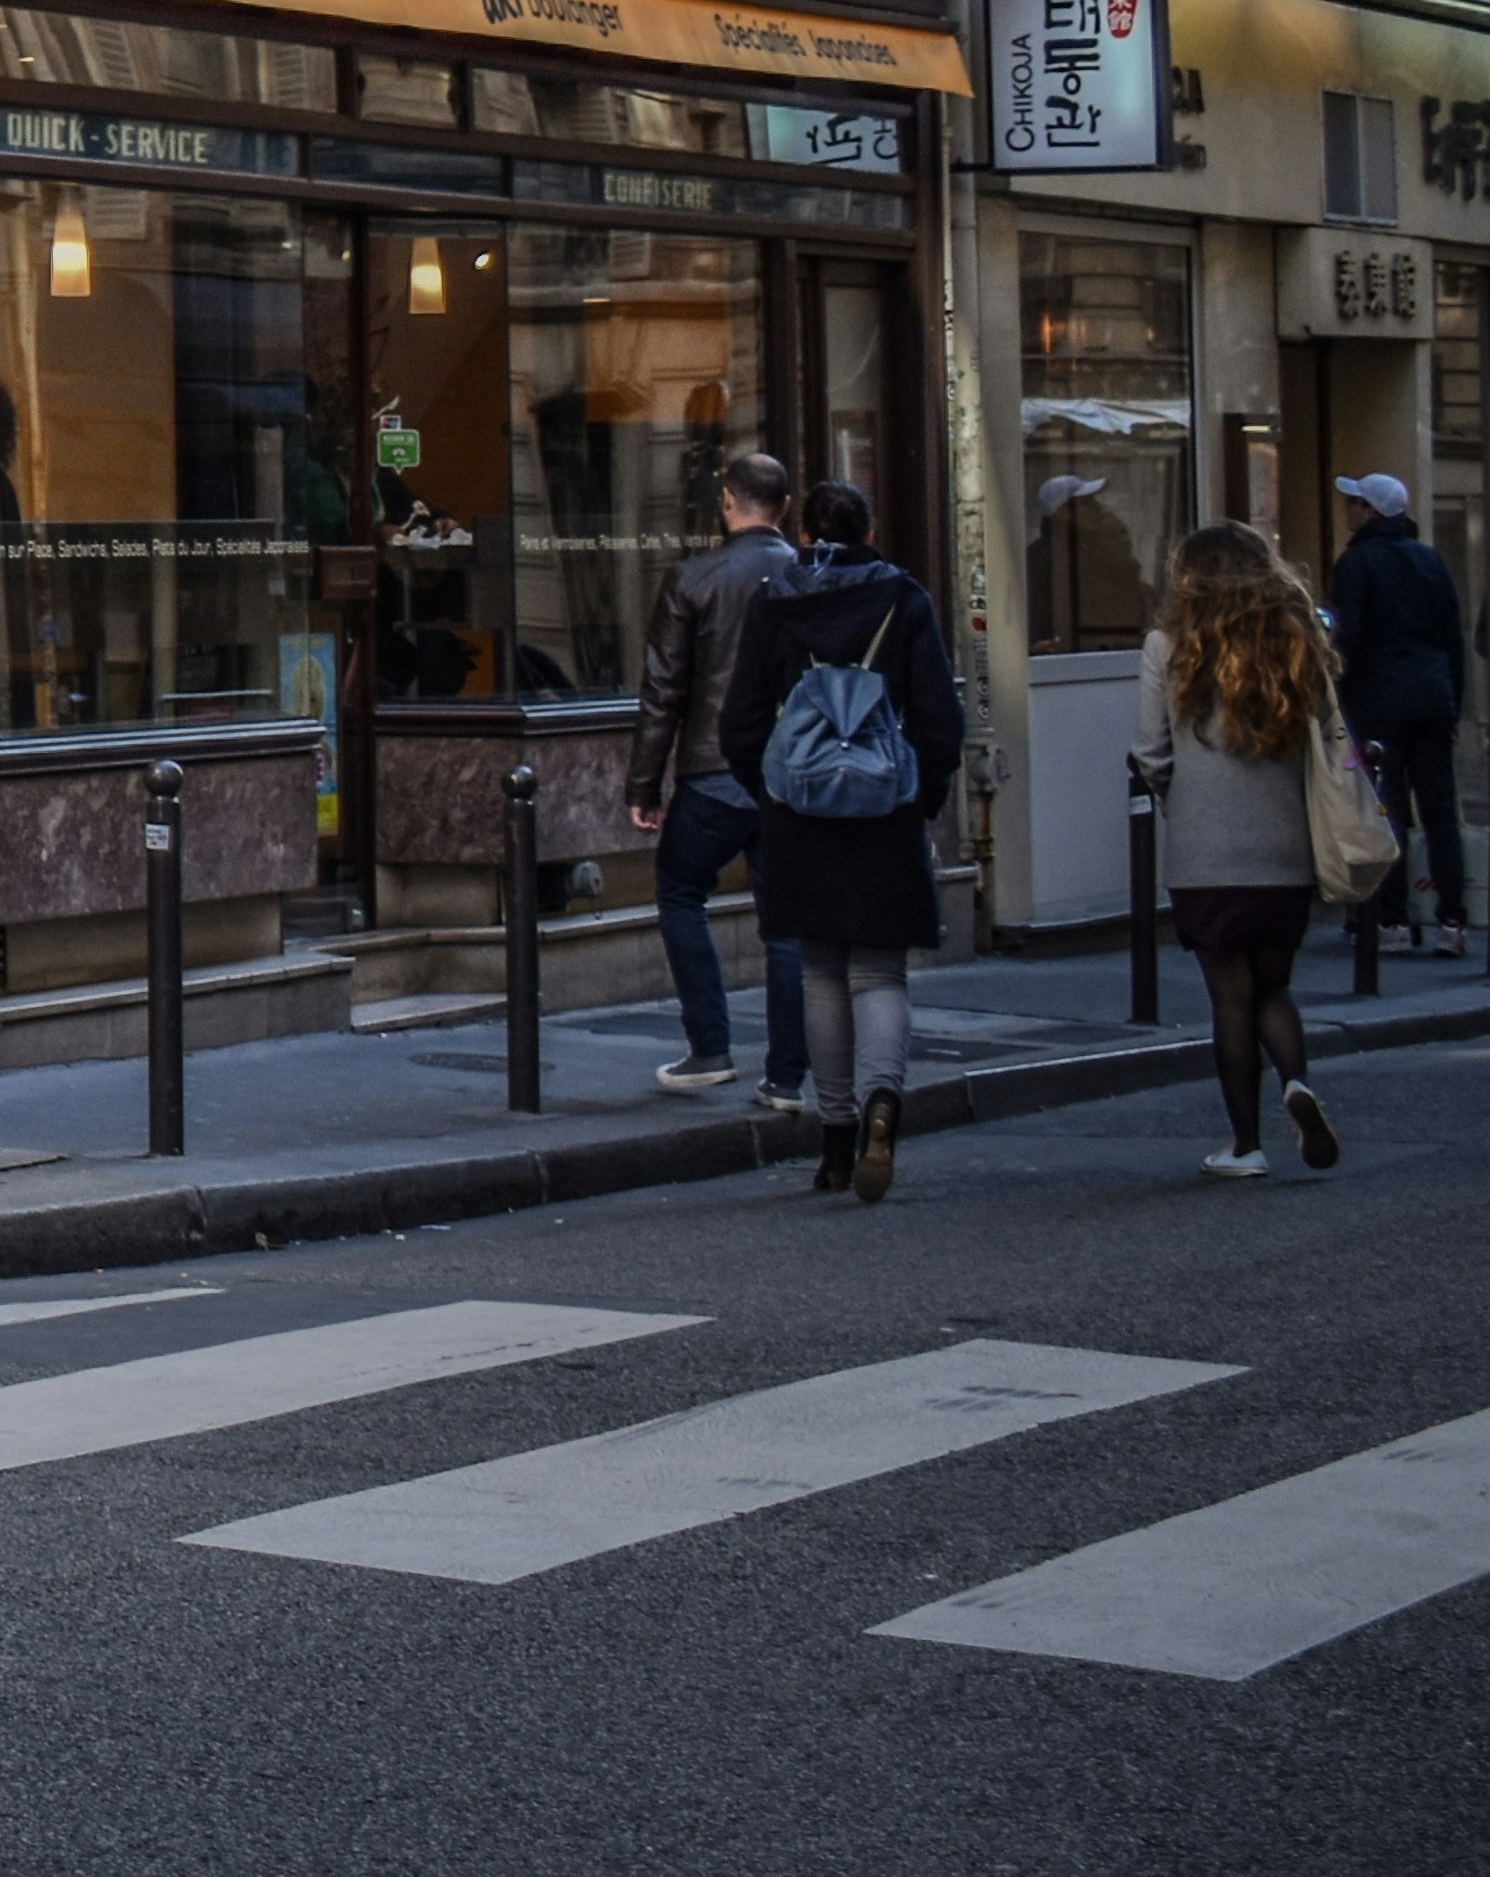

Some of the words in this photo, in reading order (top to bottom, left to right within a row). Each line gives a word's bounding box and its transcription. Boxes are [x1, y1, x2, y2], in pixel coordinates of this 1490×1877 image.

[1005, 33, 1036, 153] CHIKOJA
[7, 111, 87, 155] QUICK
[105, 121, 210, 165] SERVICE
[603, 173, 716, 212] CONFISERIE
